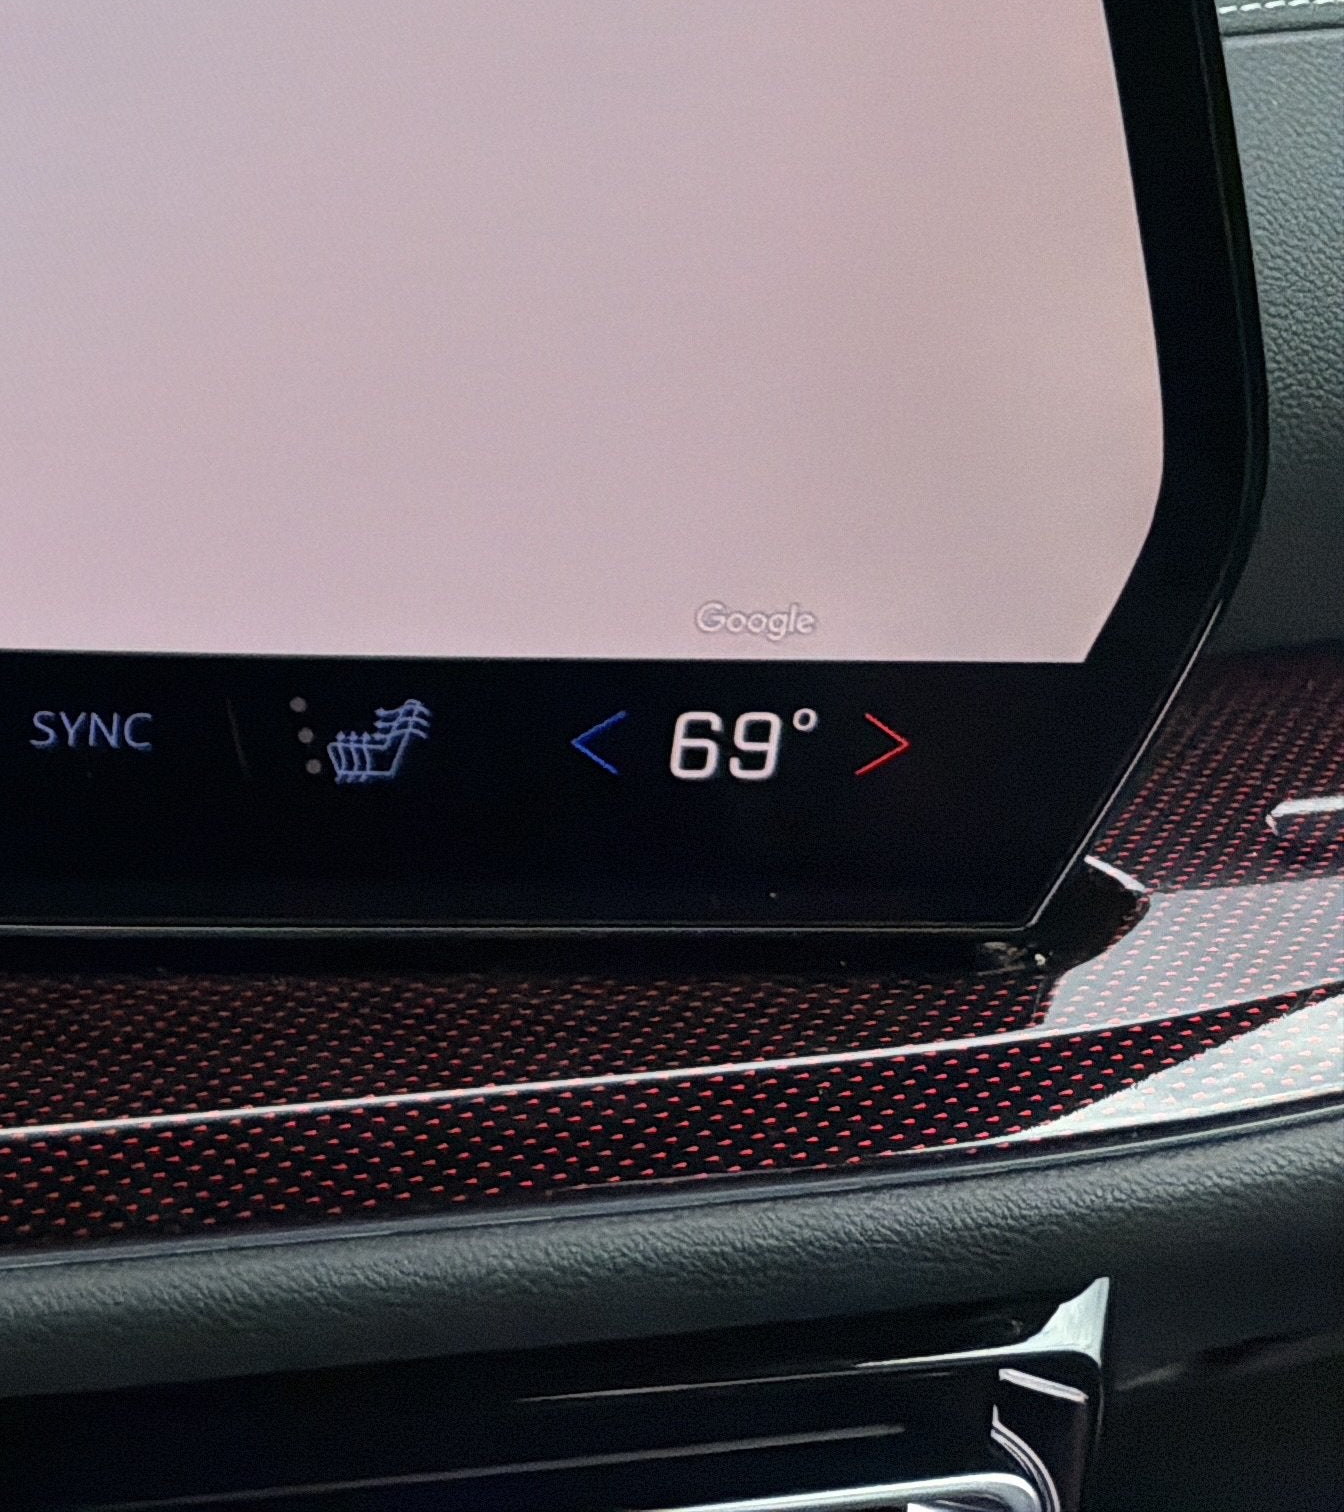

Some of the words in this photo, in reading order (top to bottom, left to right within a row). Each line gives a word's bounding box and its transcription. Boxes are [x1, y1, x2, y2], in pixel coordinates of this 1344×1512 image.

[695, 602, 817, 643] Google
[29, 710, 152, 750] SYNC
[669, 707, 818, 780] 69°
